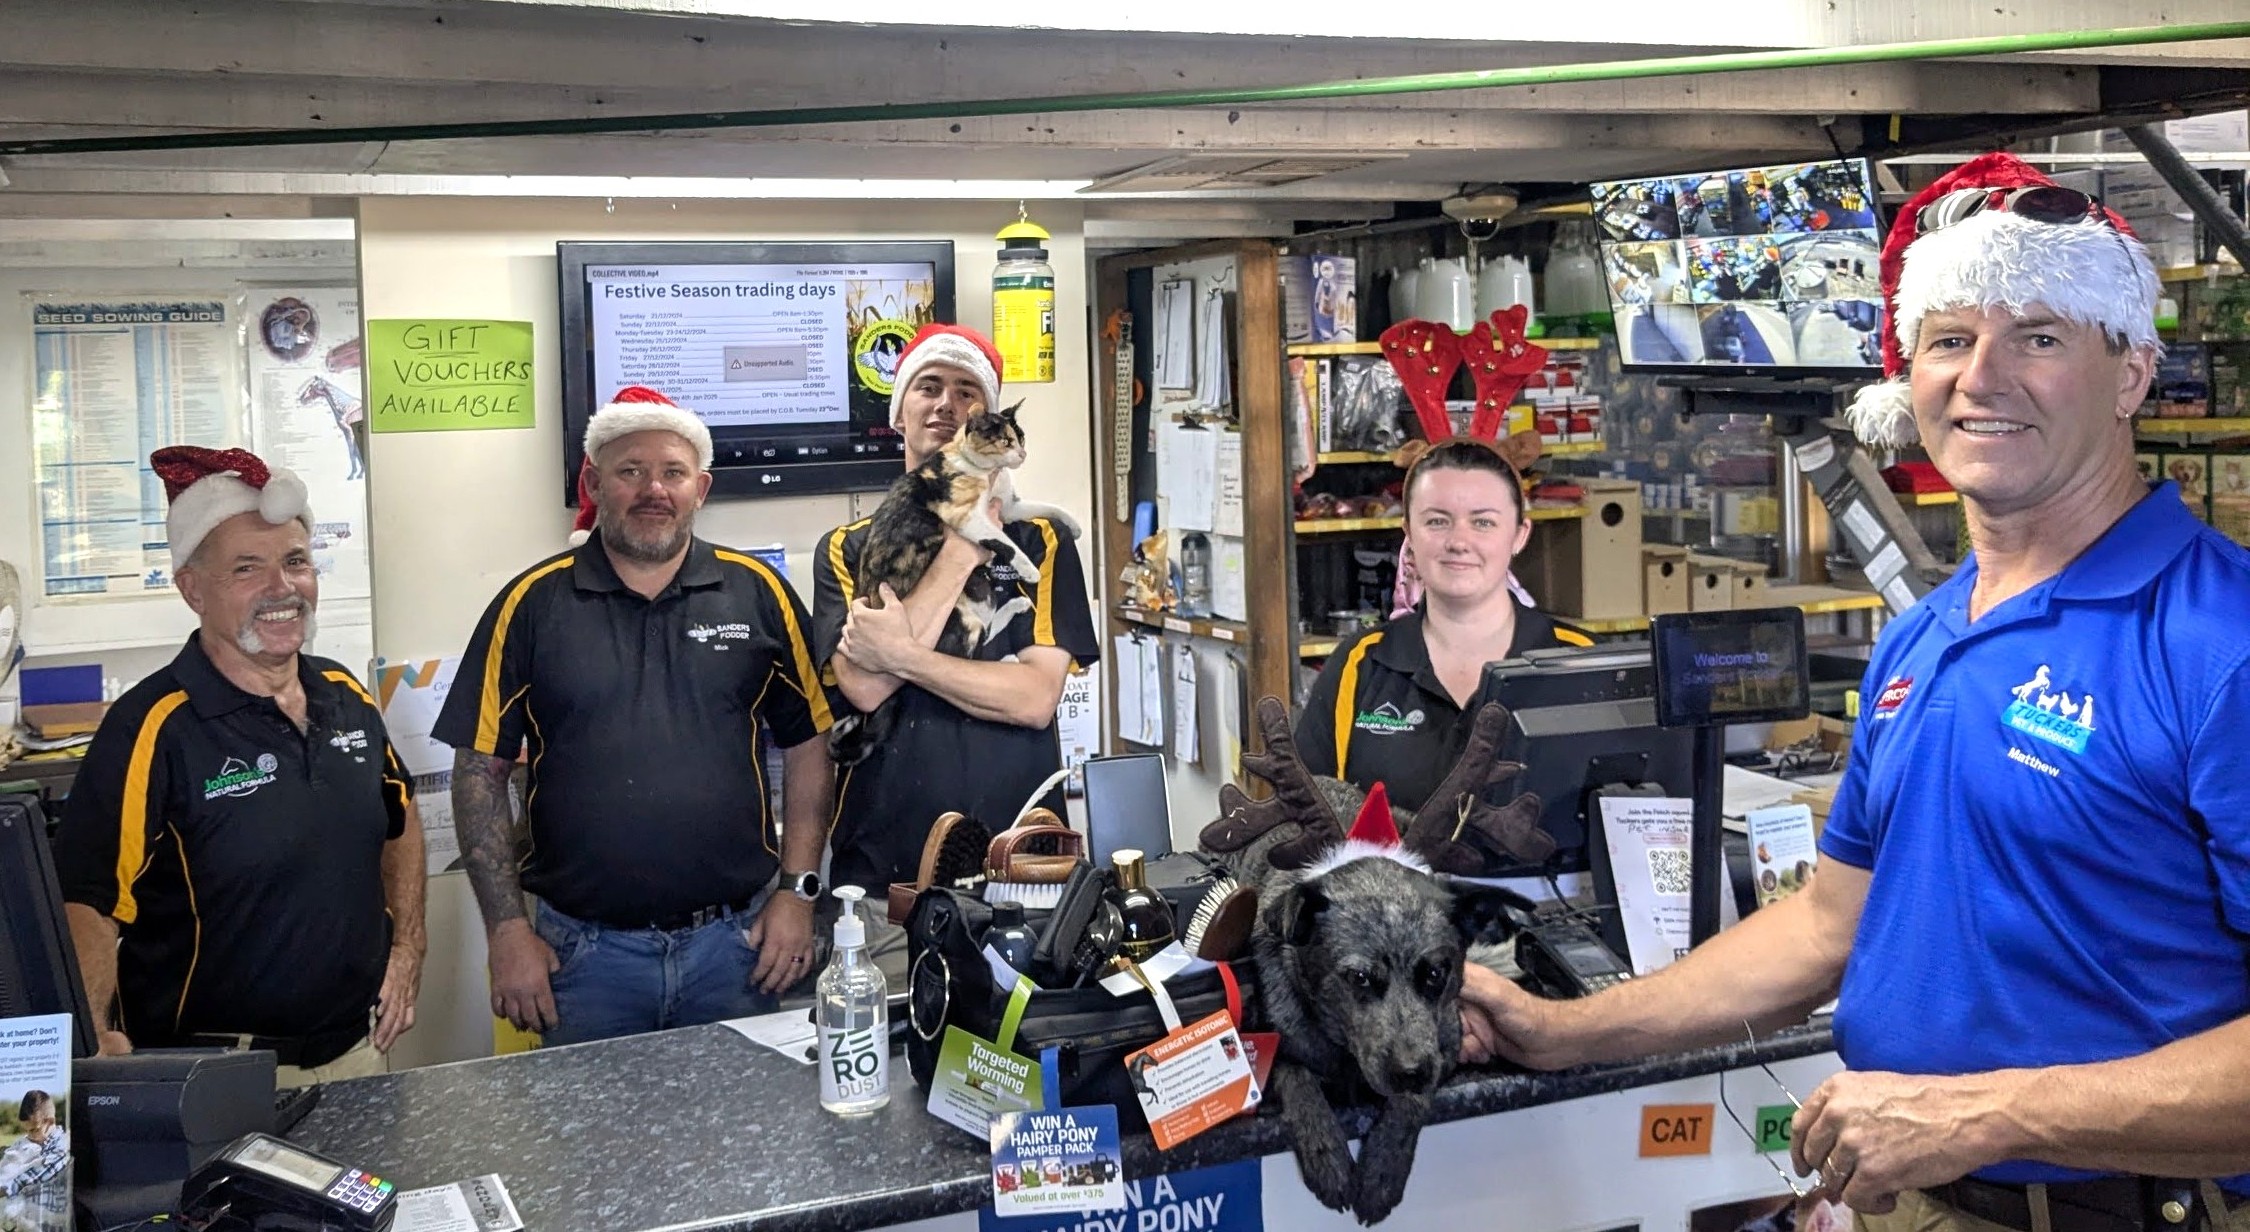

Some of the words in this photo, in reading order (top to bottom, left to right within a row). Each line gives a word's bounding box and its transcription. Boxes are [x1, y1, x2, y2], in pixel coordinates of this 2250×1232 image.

[592, 269, 626, 278] COLLECTIVE
[628, 268, 659, 278] VIDEO.mp4
[604, 284, 667, 298] Festive
[671, 283, 731, 298] Season
[735, 283, 795, 300] trading
[799, 281, 836, 299] days
[38, 313, 85, 323] SEED
[92, 312, 163, 322] SOWING
[170, 311, 222, 321] GUIDE
[403, 324, 488, 350] GIFT
[394, 359, 532, 384] VOUCHERS
[744, 360, 778, 368] Unsupported
[779, 359, 794, 367] Audio
[380, 394, 520, 417] AVAILABLE
[751, 405, 769, 415] placed
[771, 405, 777, 414] by
[717, 624, 750, 632] SANDERS
[1694, 652, 1753, 667] Welcome
[1756, 651, 1768, 662] to
[1065, 681, 1091, 692] OAT
[2013, 705, 2081, 738] TUCKERS
[2008, 747, 2060, 777] Matthew
[205, 784, 242, 800] NATURAL
[241, 774, 277, 788] FORMULA
[29, 1037, 59, 1047] property!
[1153, 1033, 1194, 1057] ENERGETIC
[1195, 1016, 1228, 1038] ISOTONIC
[832, 1051, 879, 1084] RO
[972, 1041, 1029, 1078] Targeted
[968, 1056, 1024, 1094] Worming
[837, 1073, 882, 1099] DUST
[88, 1096, 120, 1105] EPSON
[1031, 1115, 1061, 1131] WIN
[1065, 1114, 1076, 1128] A
[1652, 1117, 1702, 1142] CAT
[1010, 1130, 1054, 1147] HAIRY
[1058, 1127, 1098, 1143] PONY
[1017, 1144, 1062, 1158] PAMPER
[1066, 1142, 1094, 1154] PACK
[1013, 1194, 1046, 1204] Valued
[1048, 1192, 1057, 1201] at
[1061, 1190, 1080, 1199] over
[1153, 1175, 1177, 1205] A
[1138, 1193, 1224, 1232] PONY
